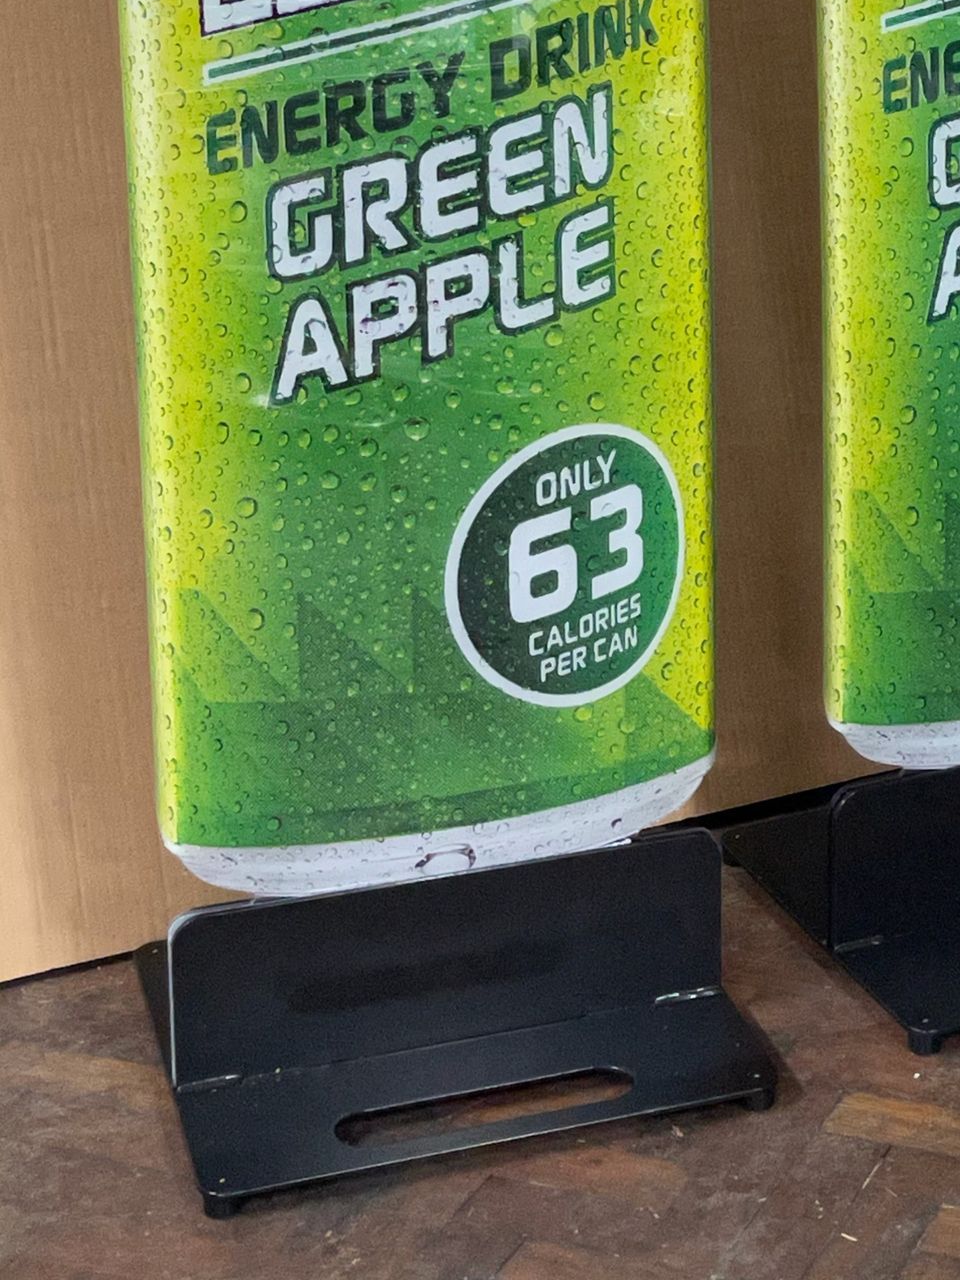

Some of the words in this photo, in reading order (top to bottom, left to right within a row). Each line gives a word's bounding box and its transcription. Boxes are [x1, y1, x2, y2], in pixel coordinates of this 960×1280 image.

[207, 51, 465, 175] ENERGY
[265, 82, 614, 284] GREEN
[267, 199, 615, 406] APPLE
[536, 449, 616, 506] ONLY
[508, 483, 644, 623] 63
[528, 592, 641, 656] CALORIES
[540, 646, 586, 682] PER
[593, 625, 637, 662] CAN
